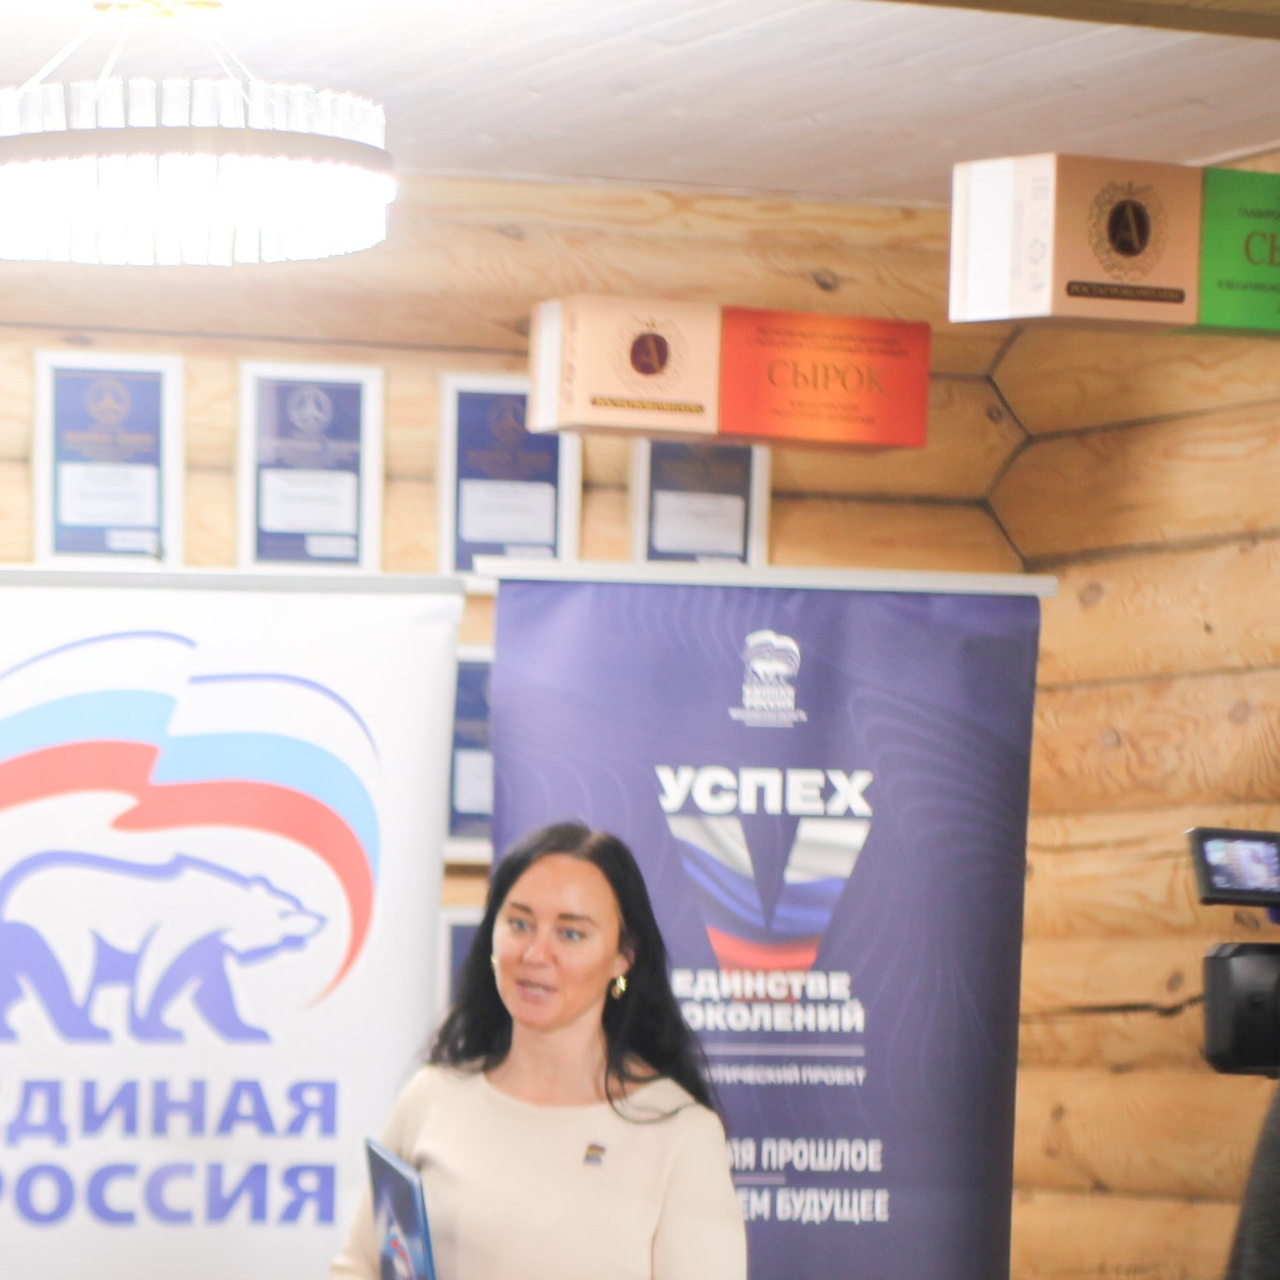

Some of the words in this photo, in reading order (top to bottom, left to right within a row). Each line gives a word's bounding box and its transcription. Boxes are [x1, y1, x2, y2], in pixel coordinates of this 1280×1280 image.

[767, 358, 887, 395] СЫРОК
[654, 764, 874, 817] УСПЕХ
[681, 997, 866, 1033] ОКОЛЕНИЙ
[802, 1064, 867, 1086] ПРОЕКТ
[761, 1138, 883, 1172] ПРОШЛОЕ
[776, 1187, 890, 1226] БУДУЩЕЕ
